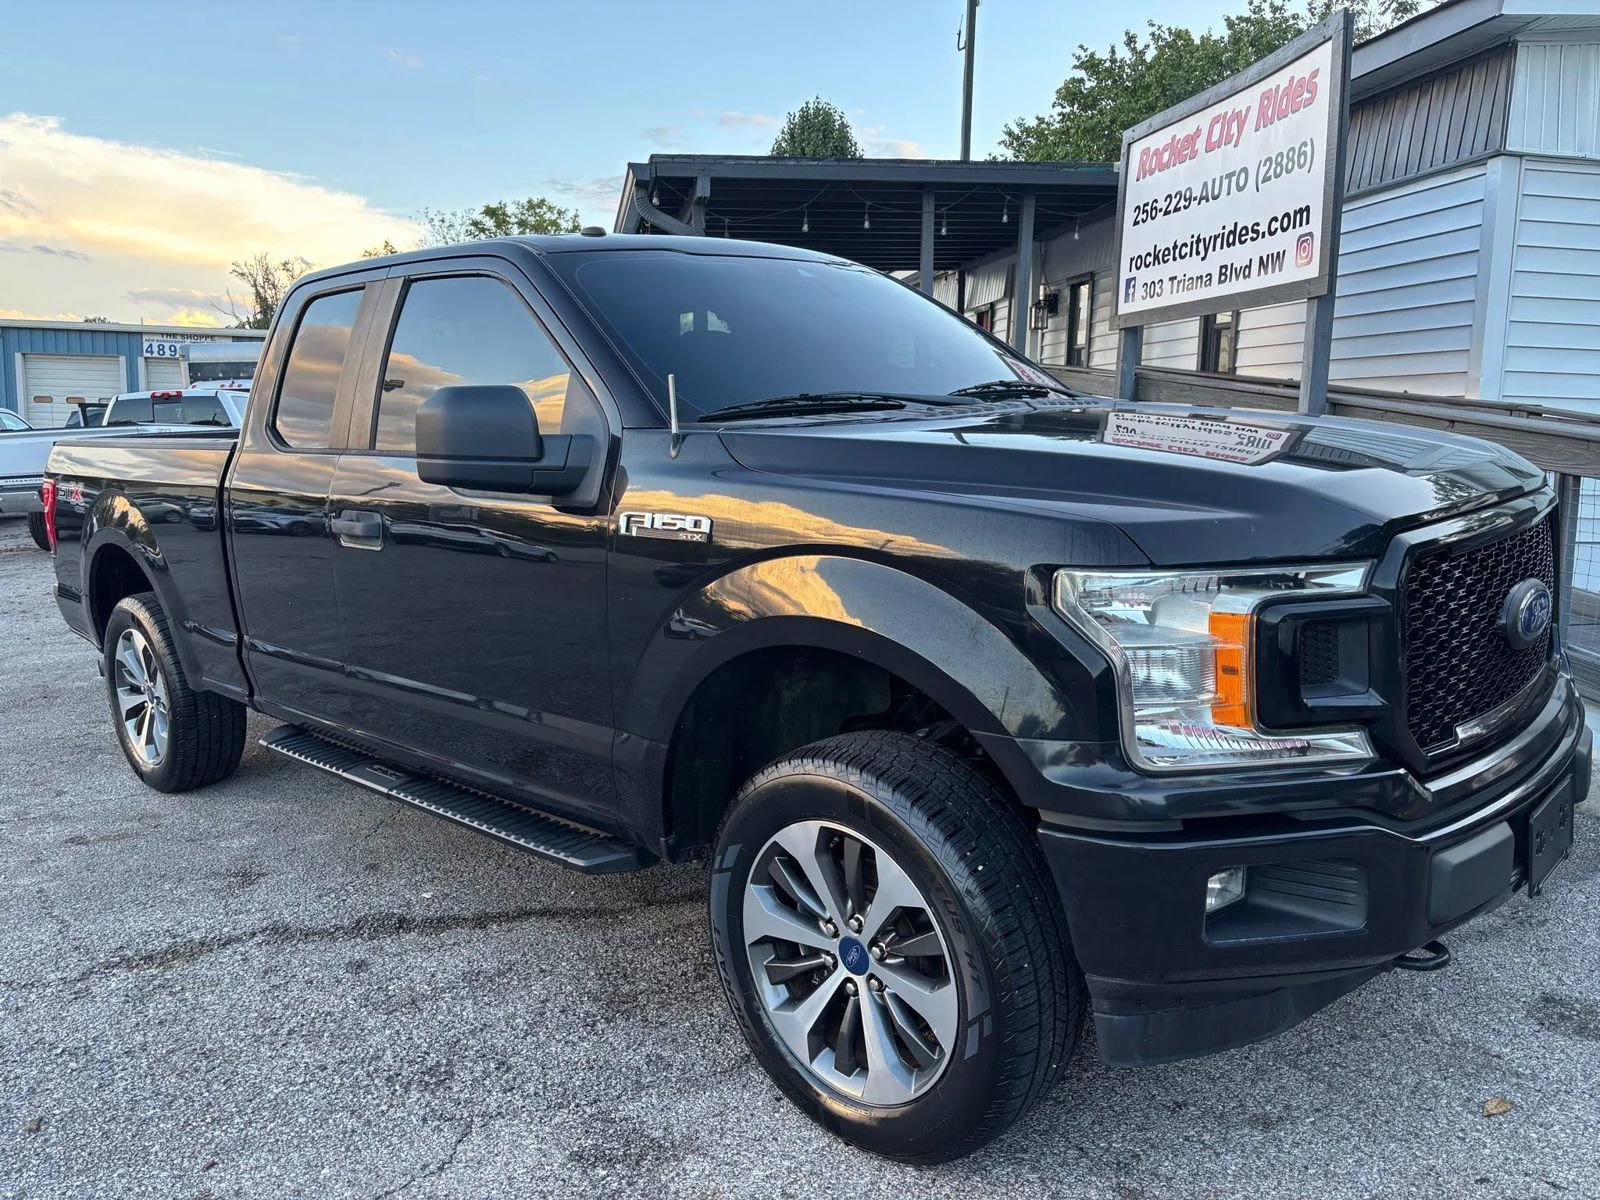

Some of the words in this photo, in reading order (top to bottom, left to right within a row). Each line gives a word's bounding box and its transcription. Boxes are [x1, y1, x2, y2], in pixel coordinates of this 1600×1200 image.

[1136, 125, 1203, 181] Rocket
[1205, 105, 1251, 153] City
[1254, 68, 1320, 132] Rides
[1132, 166, 1249, 227] 256-229-AUTO
[1255, 138, 1315, 192] (2886)
[1128, 204, 1311, 273] rocketcityrides.com
[1141, 278, 1164, 300] 303
[1168, 272, 1212, 294] Triana
[1217, 259, 1252, 285] Blvd
[1257, 250, 1287, 277] NW
[145, 343, 178, 357] 489
[180, 333, 217, 342] SHOPPE
[679, 533, 702, 541] STX
